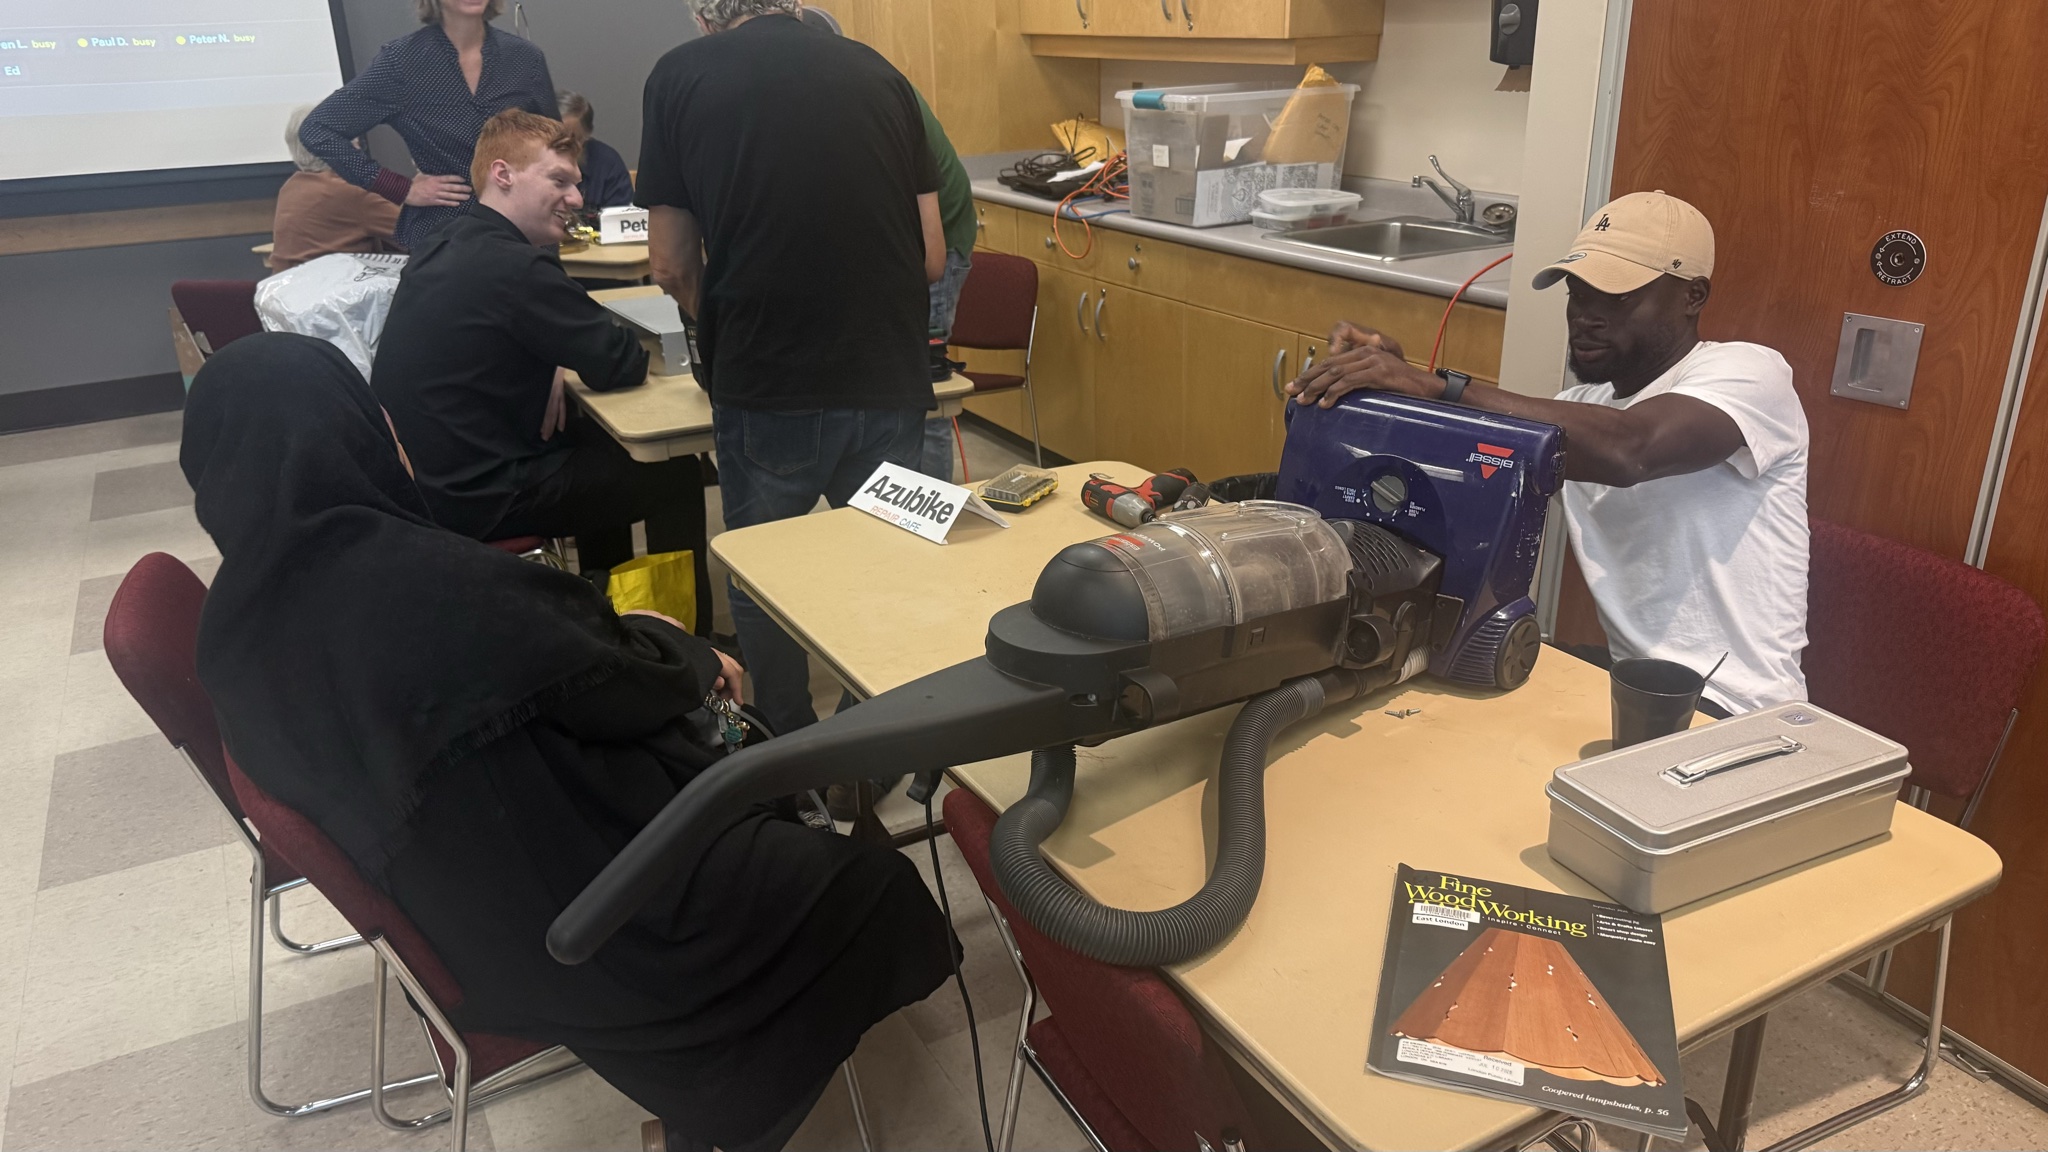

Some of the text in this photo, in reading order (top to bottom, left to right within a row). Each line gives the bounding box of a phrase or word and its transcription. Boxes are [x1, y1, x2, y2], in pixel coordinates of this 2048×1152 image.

[31, 40, 56, 50] busy
[90, 36, 156, 48] Paul D. busy
[189, 34, 217, 44] Peter
[233, 34, 256, 43] busy
[3, 65, 21, 76] Ed
[620, 218, 648, 233] Pet
[1594, 213, 1610, 231] LA
[1885, 232, 1917, 245] EXTEND
[1876, 271, 1912, 285] RETRACT
[863, 475, 955, 525] Azubike
[869, 505, 922, 532] REPAIR CAFE
[1438, 875, 1493, 898] Fine
[1434, 917, 1465, 927] London
[1487, 916, 1562, 936] Inspire Connect
[1483, 1055, 1512, 1067] Received
[1541, 1085, 1584, 1100] Coopered
[1585, 1095, 1642, 1112] lampshades,
[1644, 1107, 1654, 1115] p.
